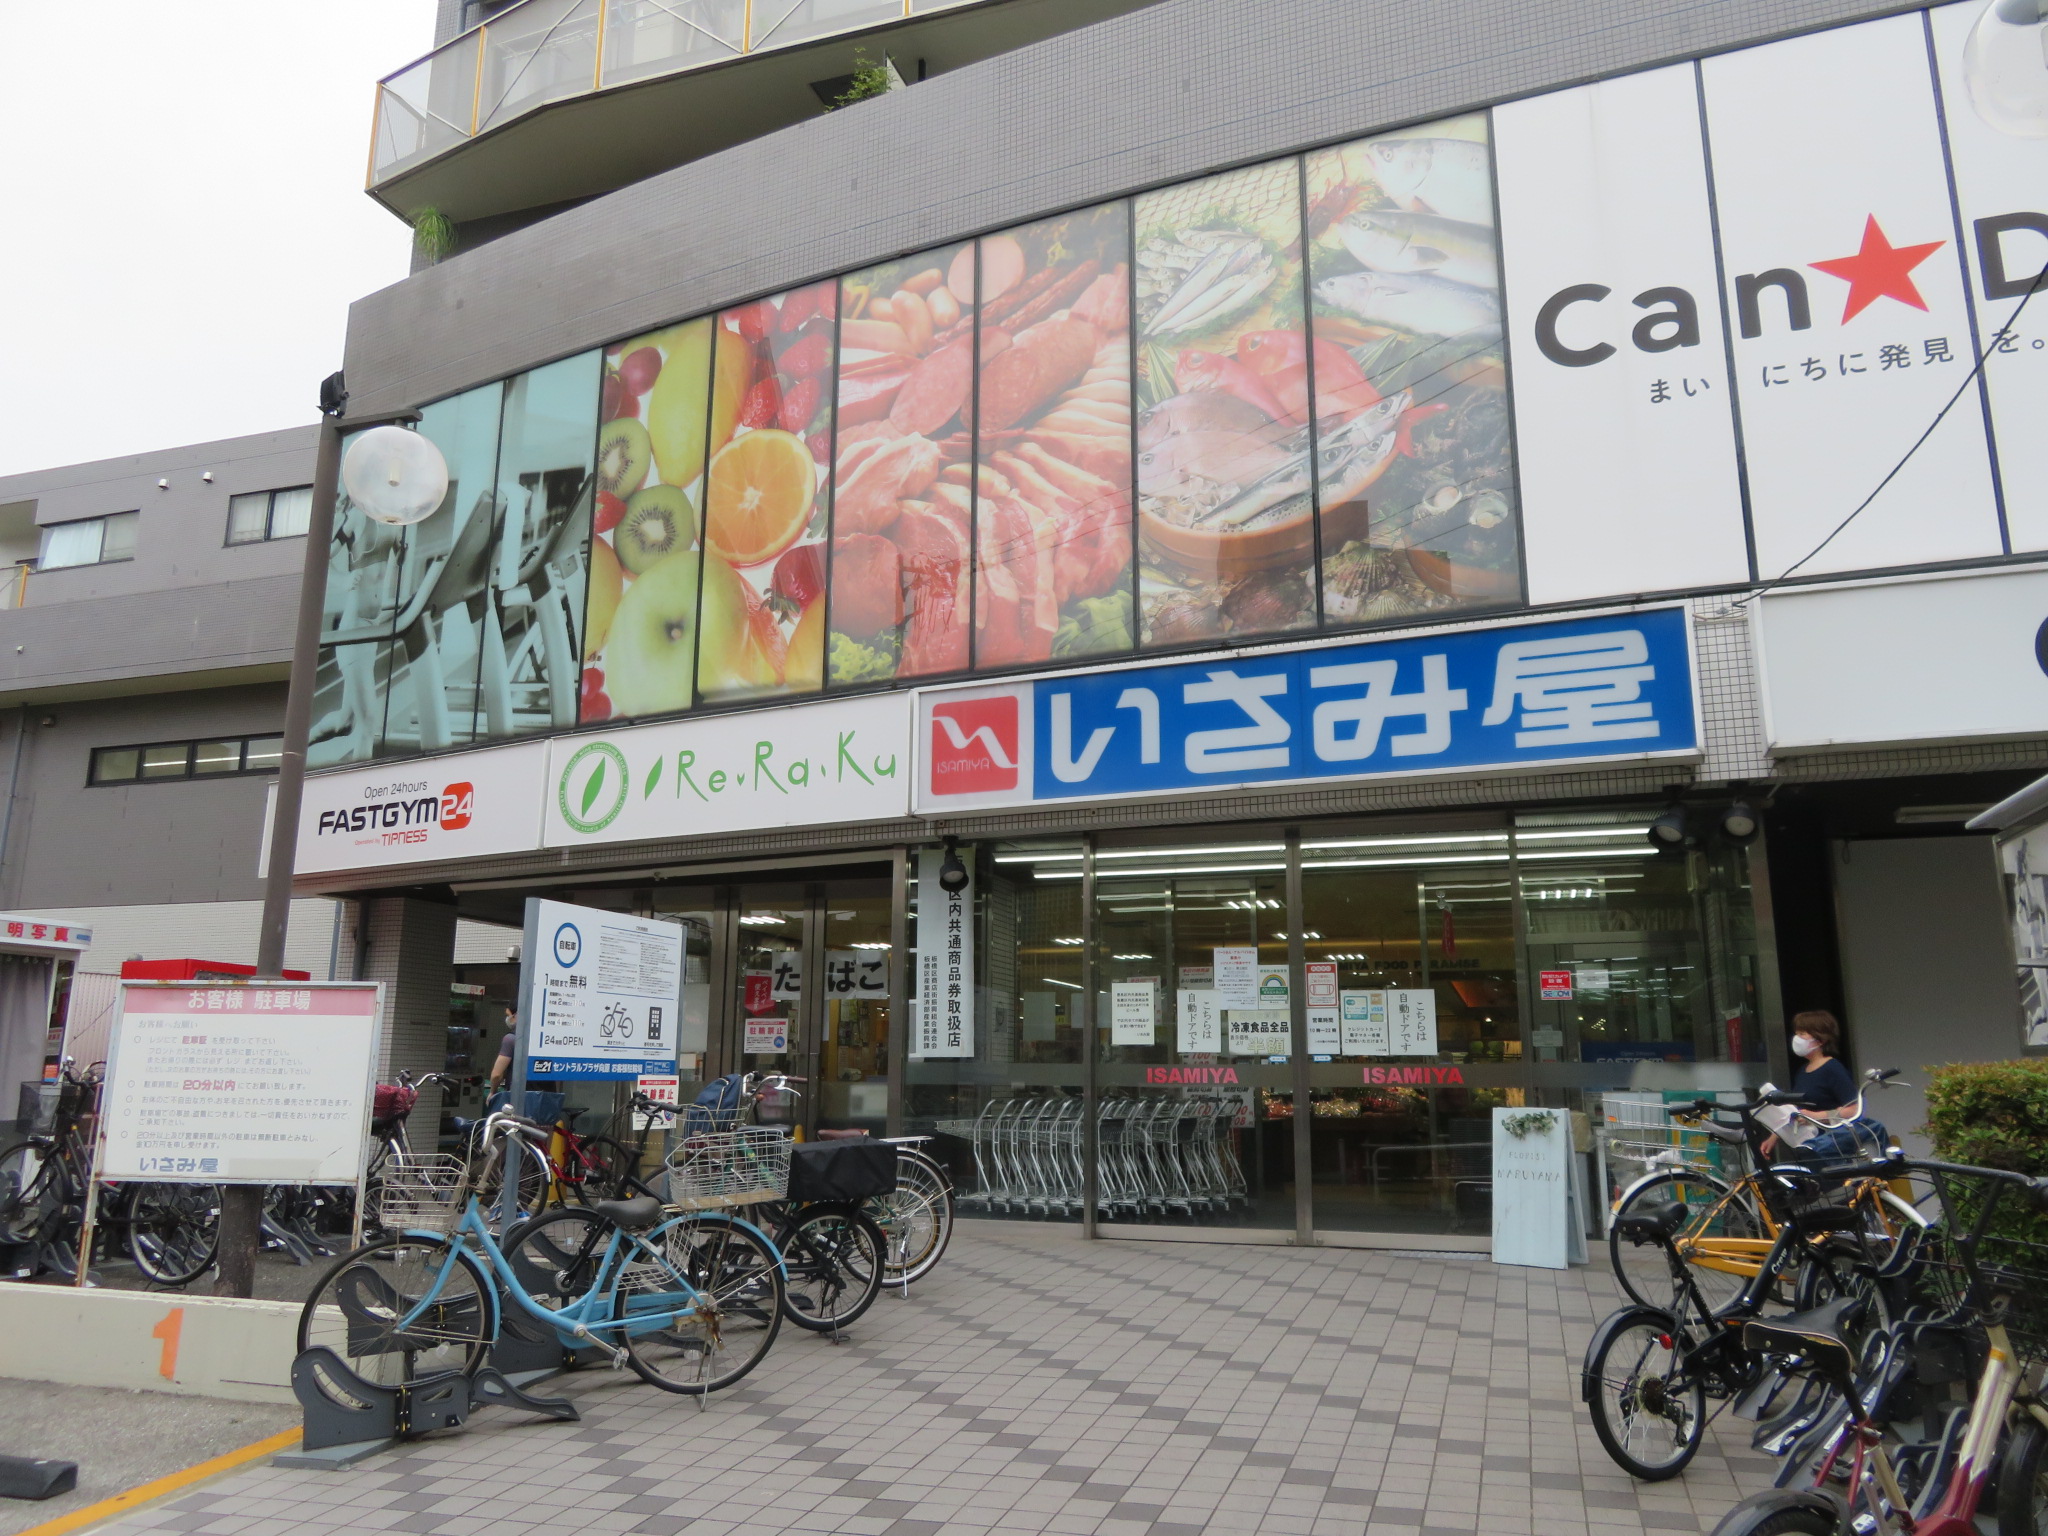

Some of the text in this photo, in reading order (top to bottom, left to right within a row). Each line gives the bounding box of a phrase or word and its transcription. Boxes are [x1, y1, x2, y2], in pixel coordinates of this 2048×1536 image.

[1050, 630, 1661, 783] いさみ屋
[937, 757, 990, 774] ISAMIYA
[365, 781, 428, 800] Open 24hours
[318, 792, 474, 836] FASTGYM 24
[381, 829, 428, 847] TIPNESS
[7, 922, 70, 942] 明写真
[774, 960, 885, 993] たばこ
[188, 990, 311, 1010] お客様 駐車場
[1543, 990, 1570, 998] SECOM
[1187, 993, 1198, 1051] 自動ドアです
[1203, 1001, 1213, 1039] こちらは
[1231, 1021, 1289, 1033] 冷凍食品全品
[1399, 992, 1411, 1053] 自動ドアです
[1415, 1002, 1428, 1042] こちらは
[182, 1079, 236, 1091] 20分以内
[1146, 1067, 1239, 1084] ISAMIYA
[1363, 1067, 1464, 1084] ISAMIYA
[139, 1157, 219, 1173] いさみ屋
[152, 1308, 184, 1381] 1
